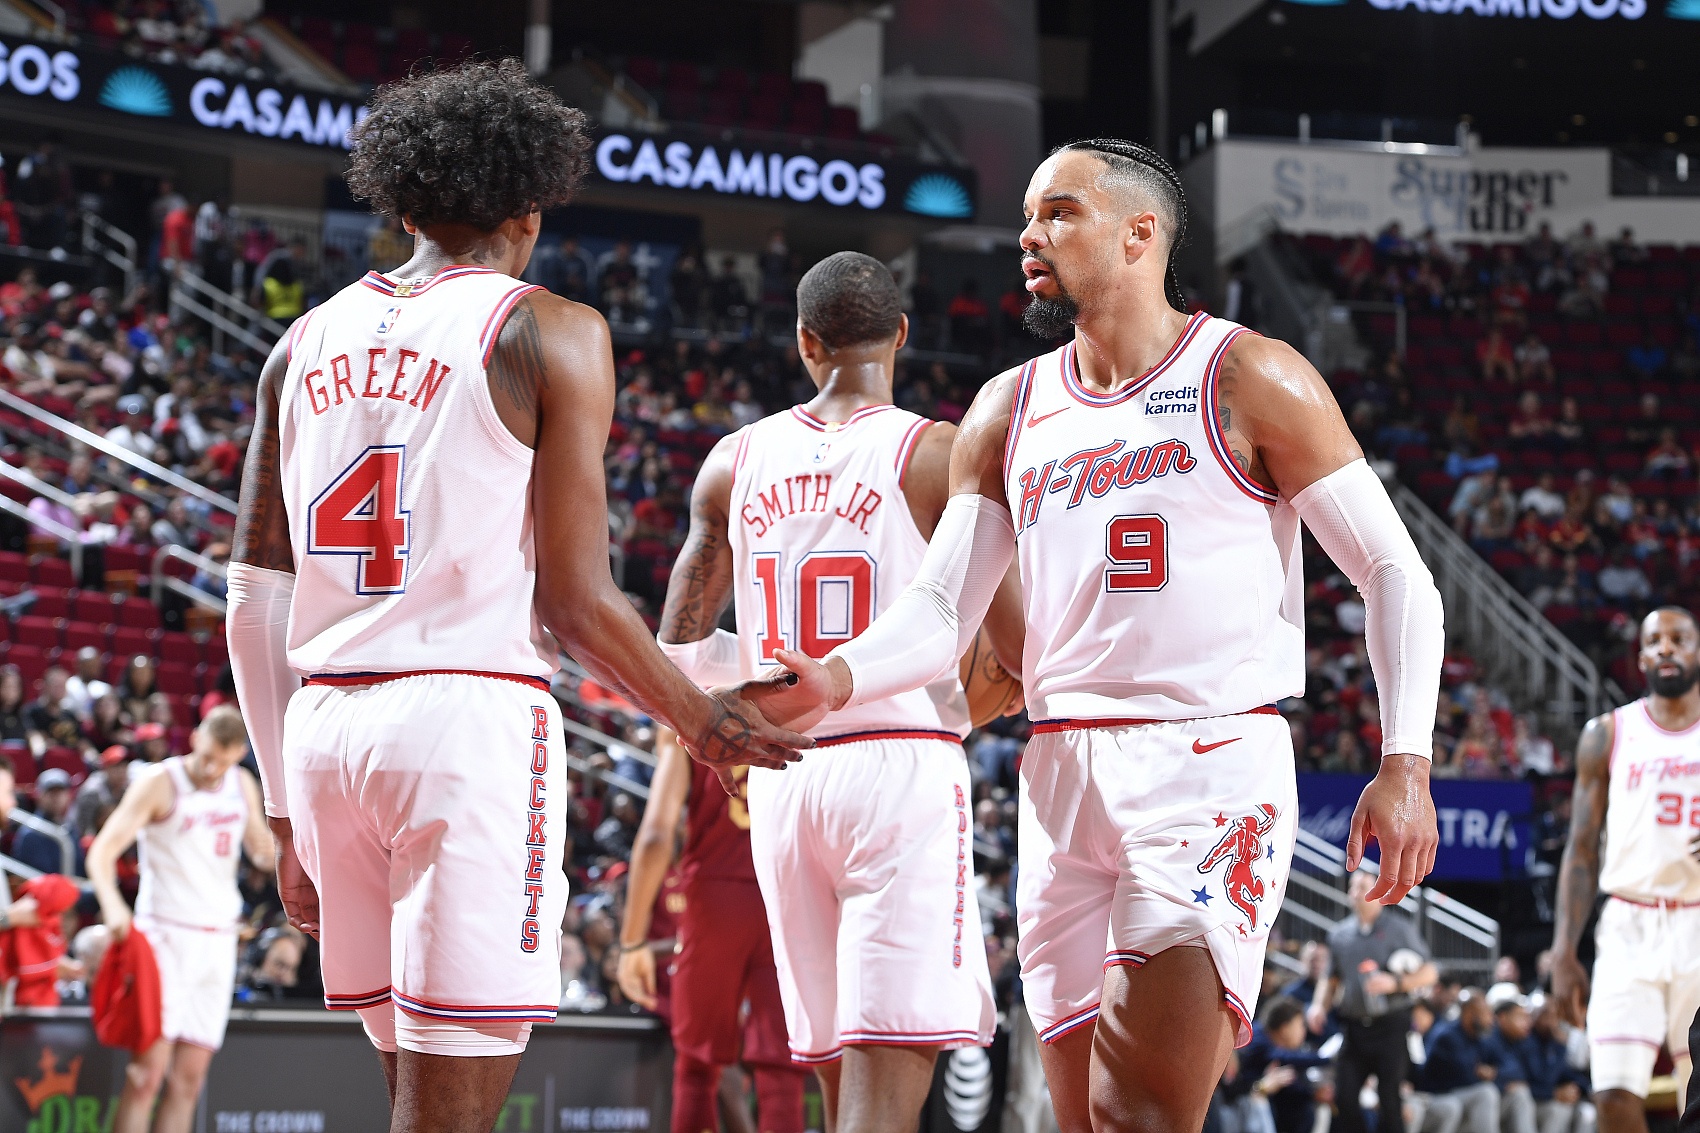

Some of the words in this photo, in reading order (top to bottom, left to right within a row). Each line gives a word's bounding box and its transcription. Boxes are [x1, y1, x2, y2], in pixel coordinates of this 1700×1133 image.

[0, 42, 81, 101] OS
[597, 134, 887, 209] CASAMIGOS
[305, 348, 451, 415] GREEN
[1145, 402, 1197, 415] karma
[1150, 386, 1199, 401] credit
[307, 444, 411, 596] 4
[741, 474, 832, 538] SMITH
[835, 482, 882, 535] JR.
[1016, 438, 1198, 538] H-Town
[1106, 513, 1169, 593] 9
[752, 551, 877, 666] 10
[521, 705, 549, 953] ROCKETS
[1438, 808, 1519, 849] TRA
[952, 782, 968, 969] ROCKETS
